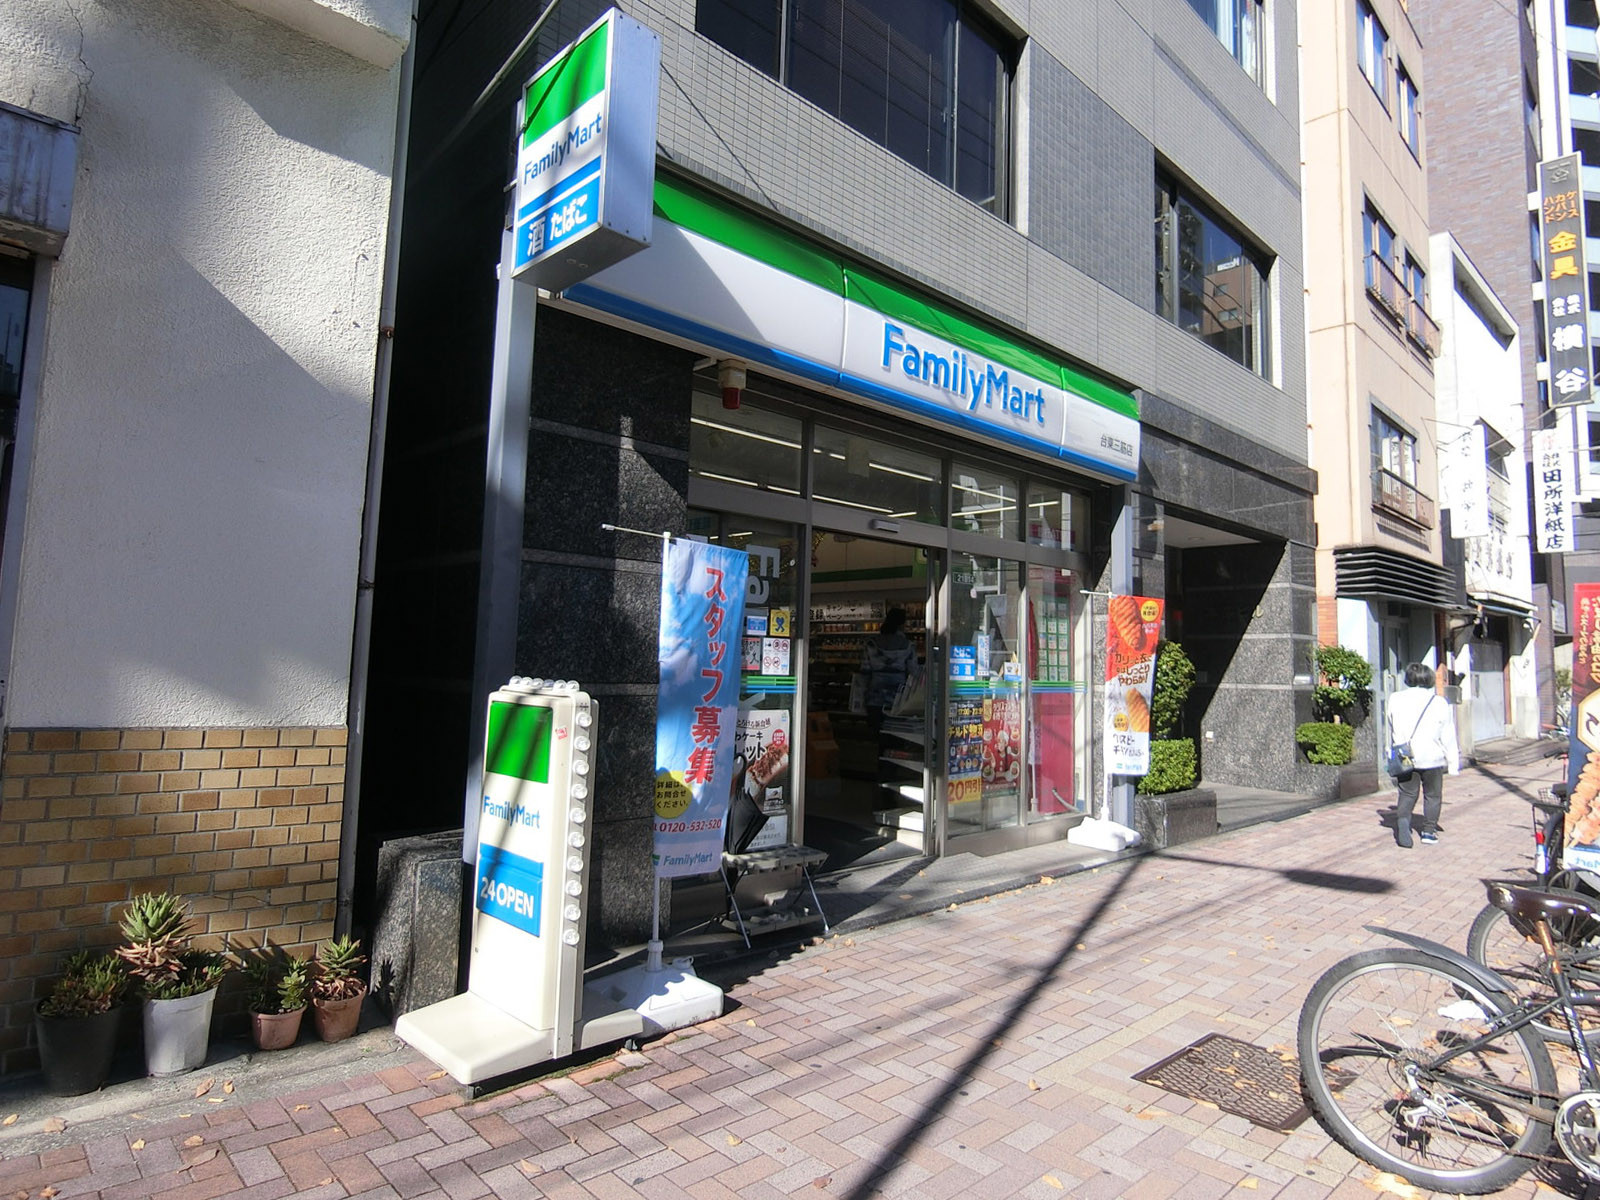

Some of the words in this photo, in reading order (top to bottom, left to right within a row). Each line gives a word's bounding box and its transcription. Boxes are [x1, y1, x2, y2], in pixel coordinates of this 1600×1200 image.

[524, 113, 602, 185] FamilyMart
[527, 215, 546, 256] 酒
[550, 194, 588, 241] たばこ
[1548, 230, 1579, 280] 金具
[881, 321, 1046, 424] FamilyMart
[1543, 468, 1565, 549] 田所洋紙店
[684, 567, 728, 785] スタッフ募集
[953, 647, 971, 658] たばこ
[482, 795, 541, 830] FamilyMart
[656, 790, 687, 799] お問合せ
[663, 852, 713, 866] FamilyMart
